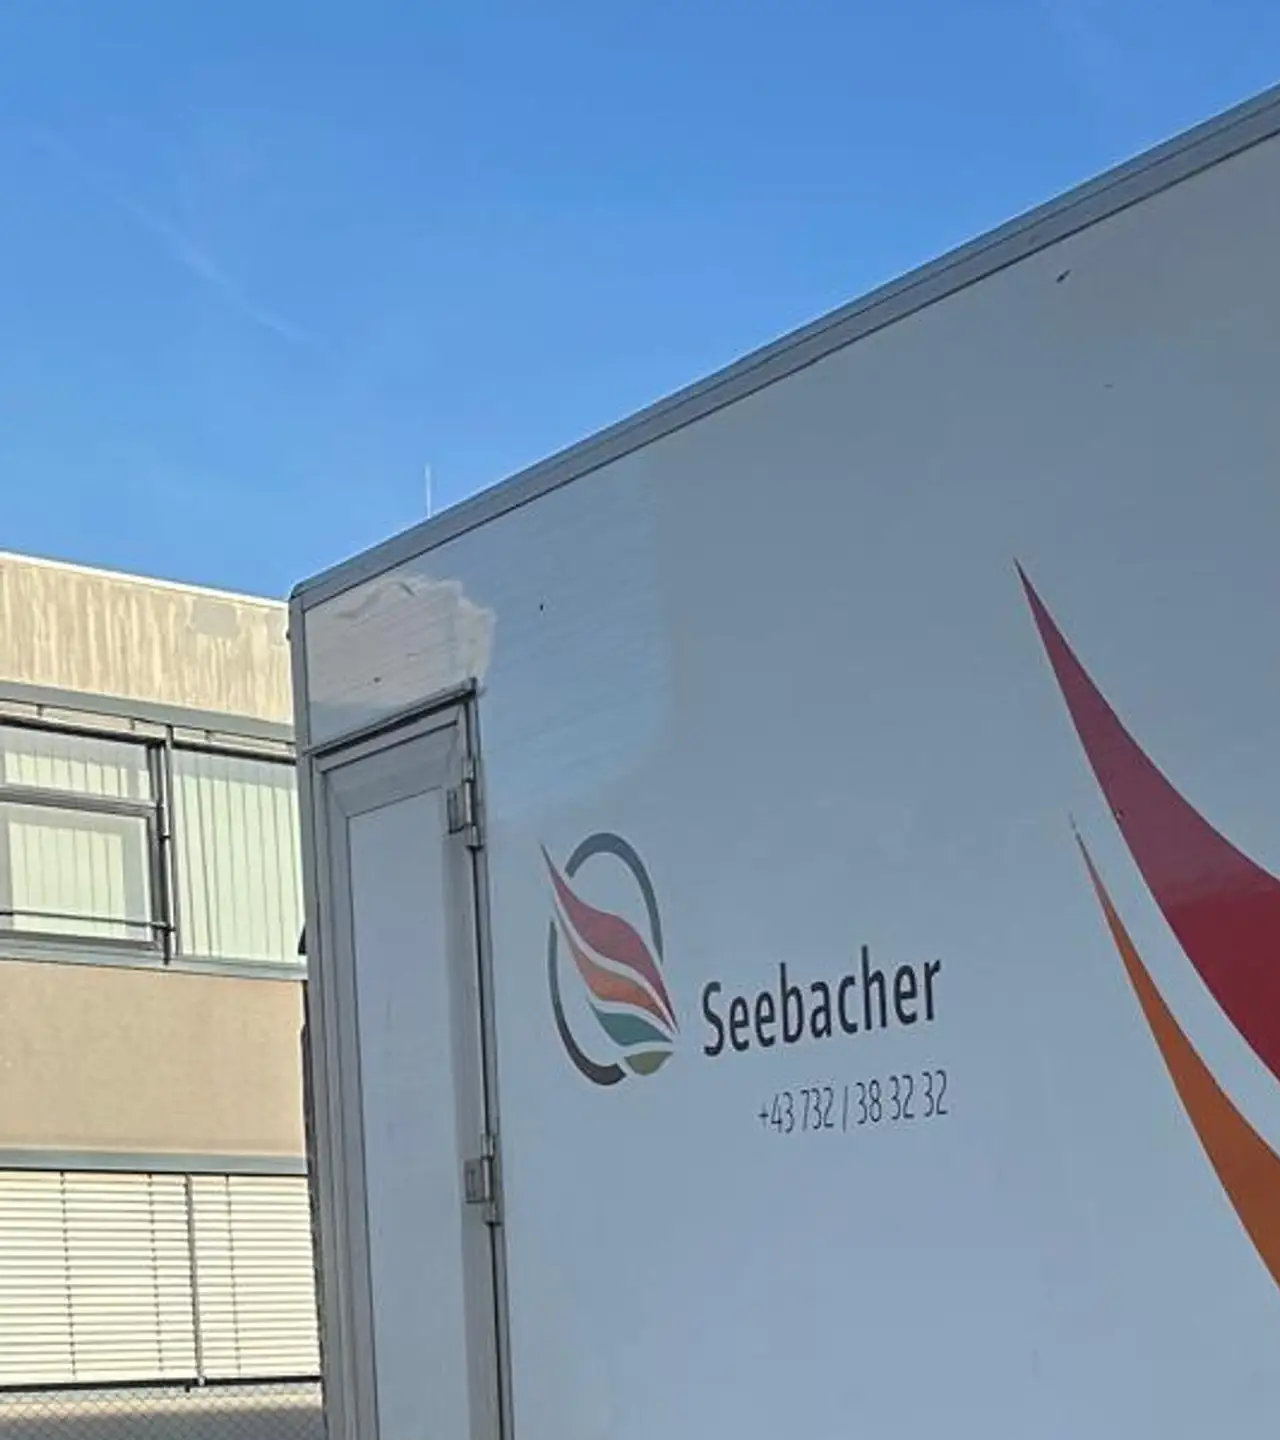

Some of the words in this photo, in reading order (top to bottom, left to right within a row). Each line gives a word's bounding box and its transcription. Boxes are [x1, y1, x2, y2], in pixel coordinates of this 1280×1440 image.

[703, 944, 941, 1057] Seebacher
[758, 1092, 795, 1133] +43
[801, 1087, 834, 1131] 732
[856, 1079, 882, 1124] 38
[890, 1075, 915, 1120] 32
[922, 1070, 949, 1117] 32
